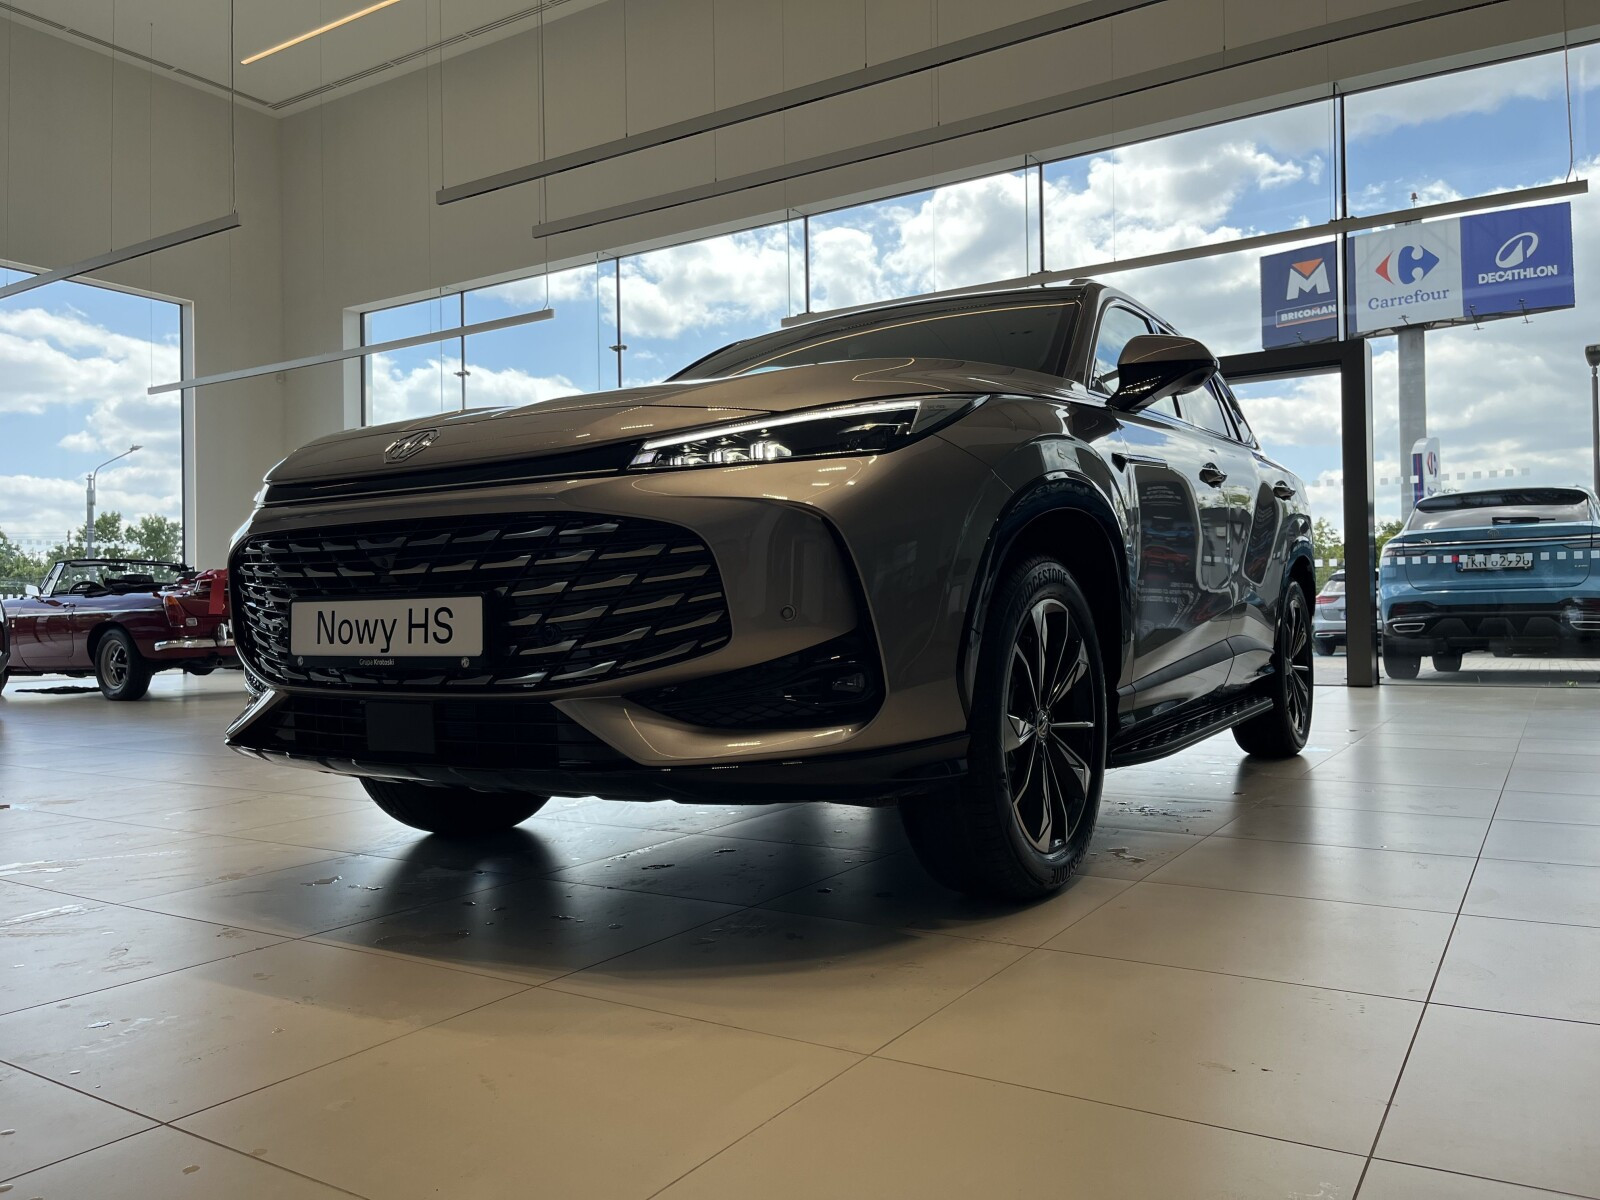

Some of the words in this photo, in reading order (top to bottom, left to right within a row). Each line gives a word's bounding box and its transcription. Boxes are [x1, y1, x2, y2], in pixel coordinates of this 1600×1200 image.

[1478, 265, 1558, 284] DECATHLON
[1368, 289, 1449, 310] Carrefour
[1281, 304, 1336, 321] BRICOMAN
[317, 610, 398, 653] Nowy
[408, 607, 453, 644] HS
[359, 658, 373, 666] Grupa
